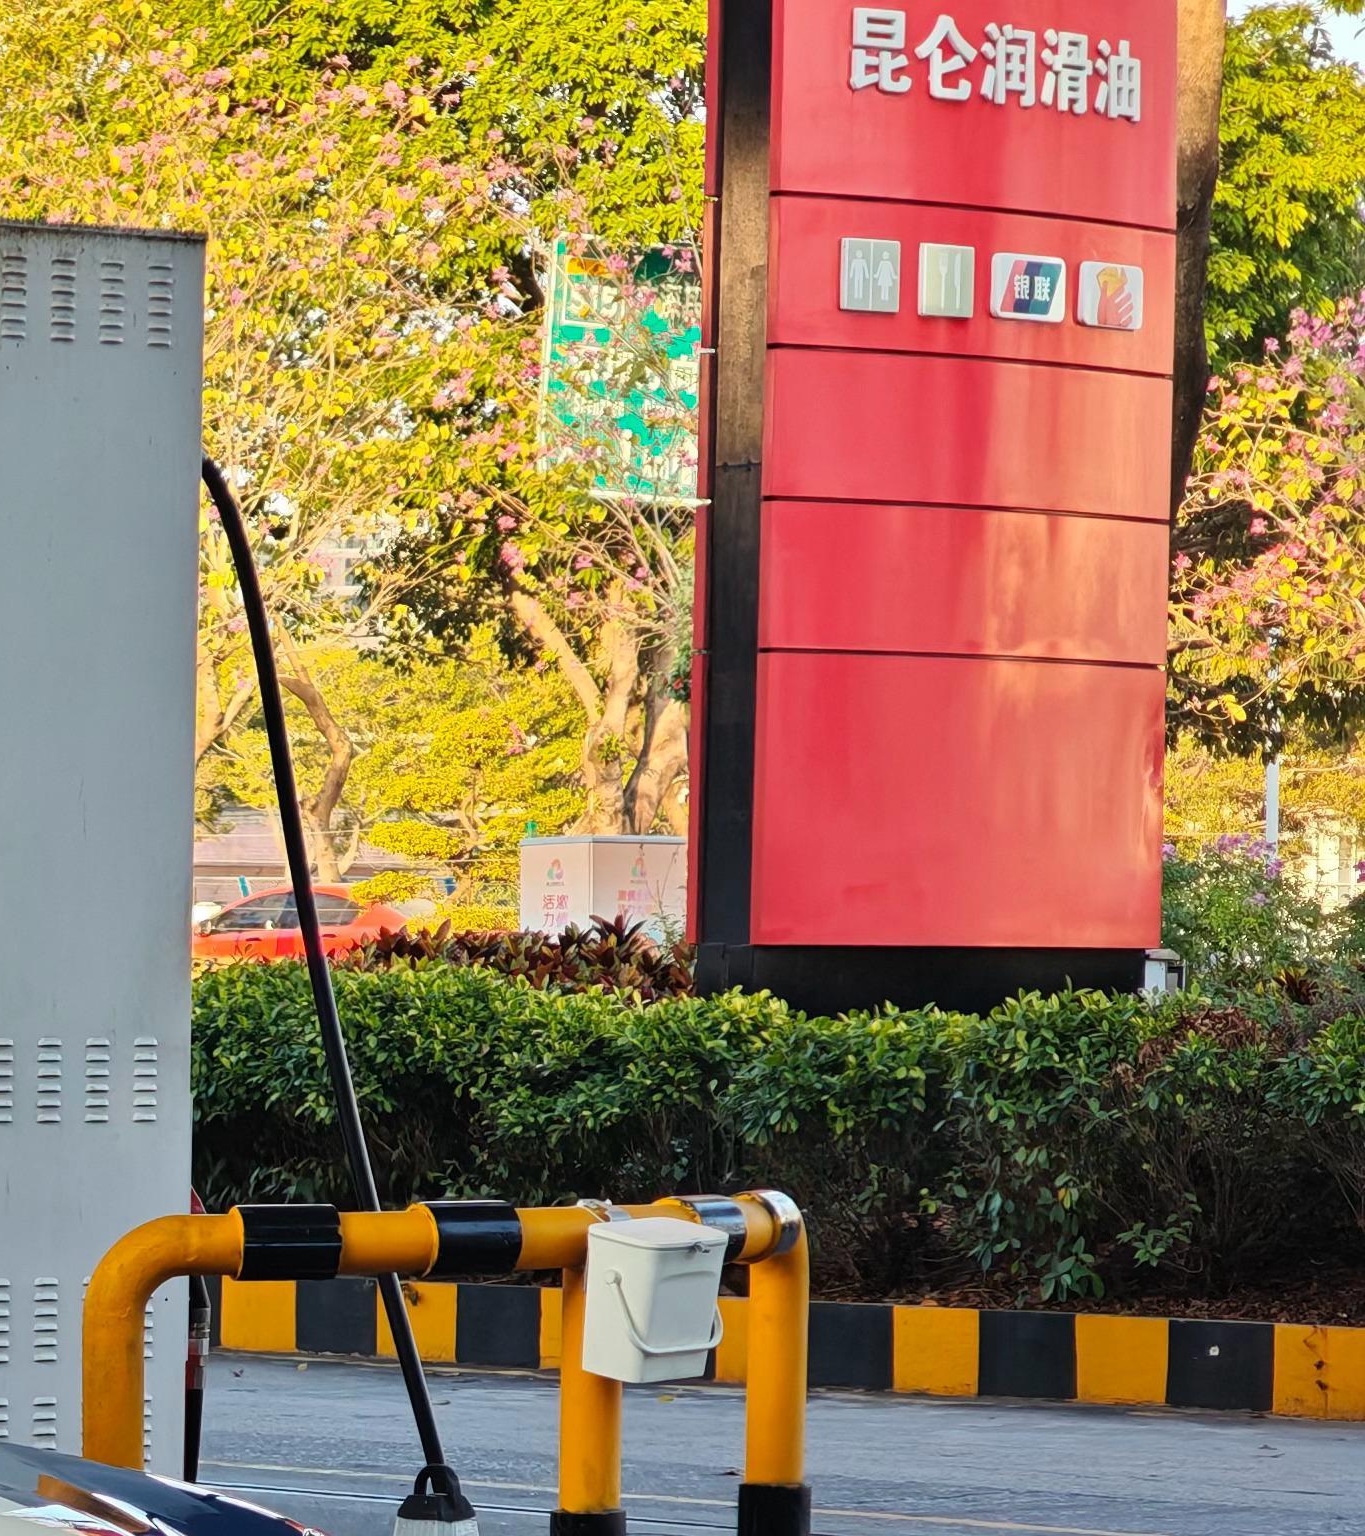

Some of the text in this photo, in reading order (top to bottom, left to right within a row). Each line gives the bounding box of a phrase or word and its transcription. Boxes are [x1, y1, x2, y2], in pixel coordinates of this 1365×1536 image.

[849, 7, 1141, 123] 昆仑润滑油
[1013, 274, 1051, 302] 银联
